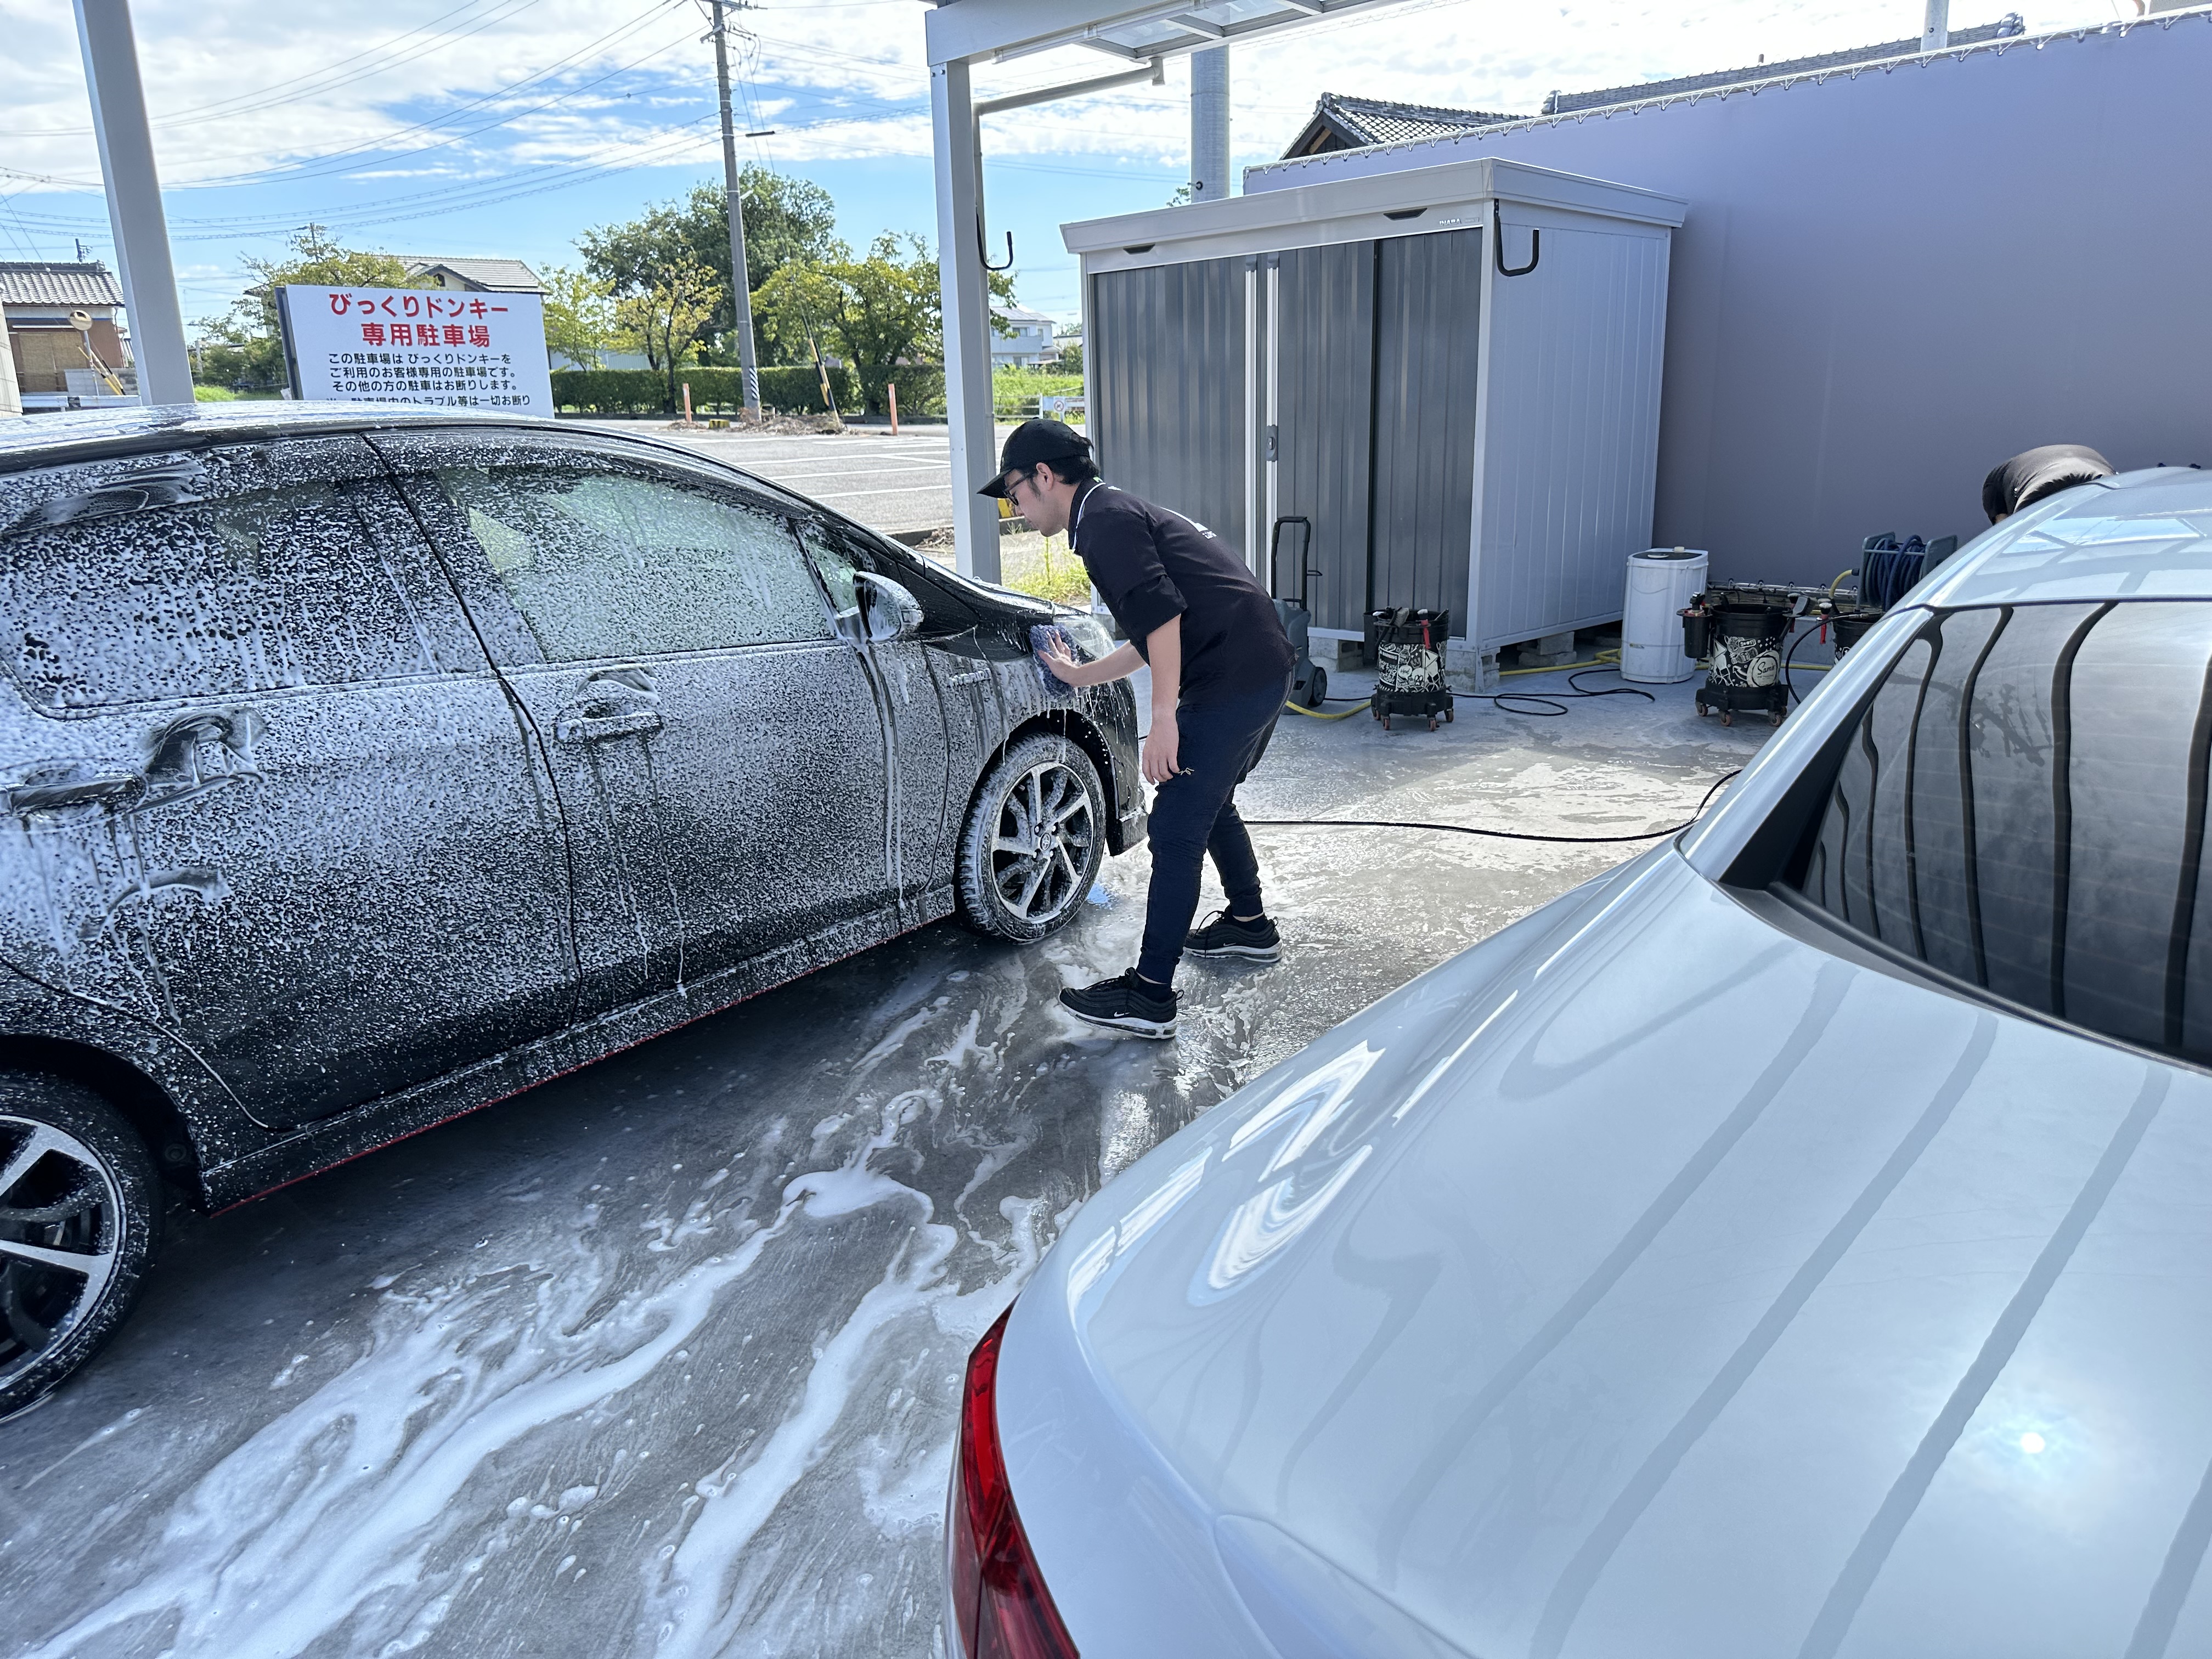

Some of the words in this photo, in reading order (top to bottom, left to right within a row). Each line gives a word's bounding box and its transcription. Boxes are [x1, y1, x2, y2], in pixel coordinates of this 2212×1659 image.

[329, 293, 508, 319] びっくりドンキー
[361, 322, 490, 347] 専用駐車場
[329, 353, 403, 364] この駐車場は
[408, 353, 511, 364] びっくりドンキーを
[330, 366, 515, 379] ご利用のお客様専用の駐車場です。
[332, 379, 516, 392] その他の方の駐車はお断りします。
